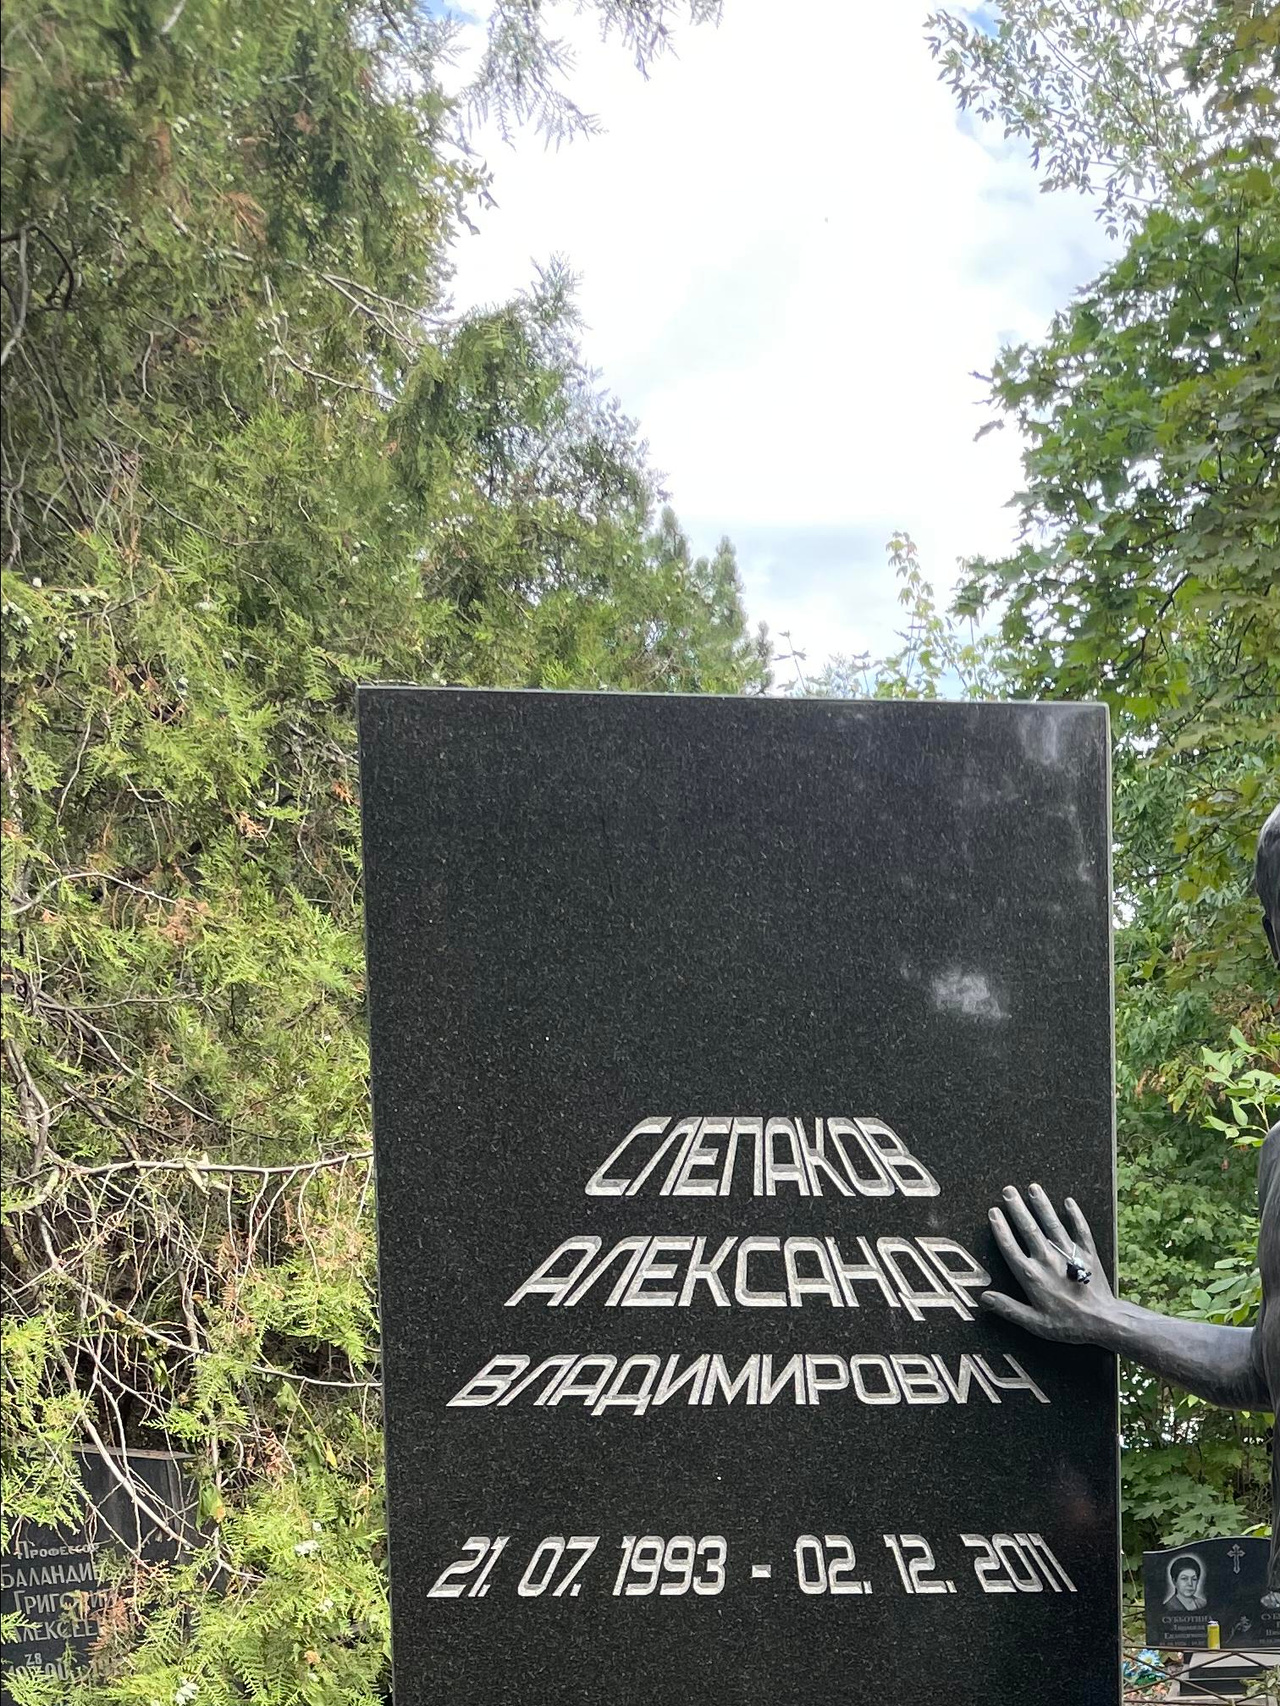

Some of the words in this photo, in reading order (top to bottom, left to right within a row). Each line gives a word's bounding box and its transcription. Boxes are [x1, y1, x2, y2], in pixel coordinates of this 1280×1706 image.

[585, 1116, 941, 1197] СЛЕПАКОВ
[504, 1235, 991, 1321] АЛЕКСАНДР
[446, 1354, 1051, 1416] ВЛАДИМИРОВИЧ
[427, 1536, 509, 1598] 21.
[518, 1536, 600, 1597] 07.
[613, 1535, 728, 1596] 1993
[793, 1535, 873, 1595] 02.
[883, 1534, 958, 1594] 12.
[960, 1533, 1078, 1592] 2011
